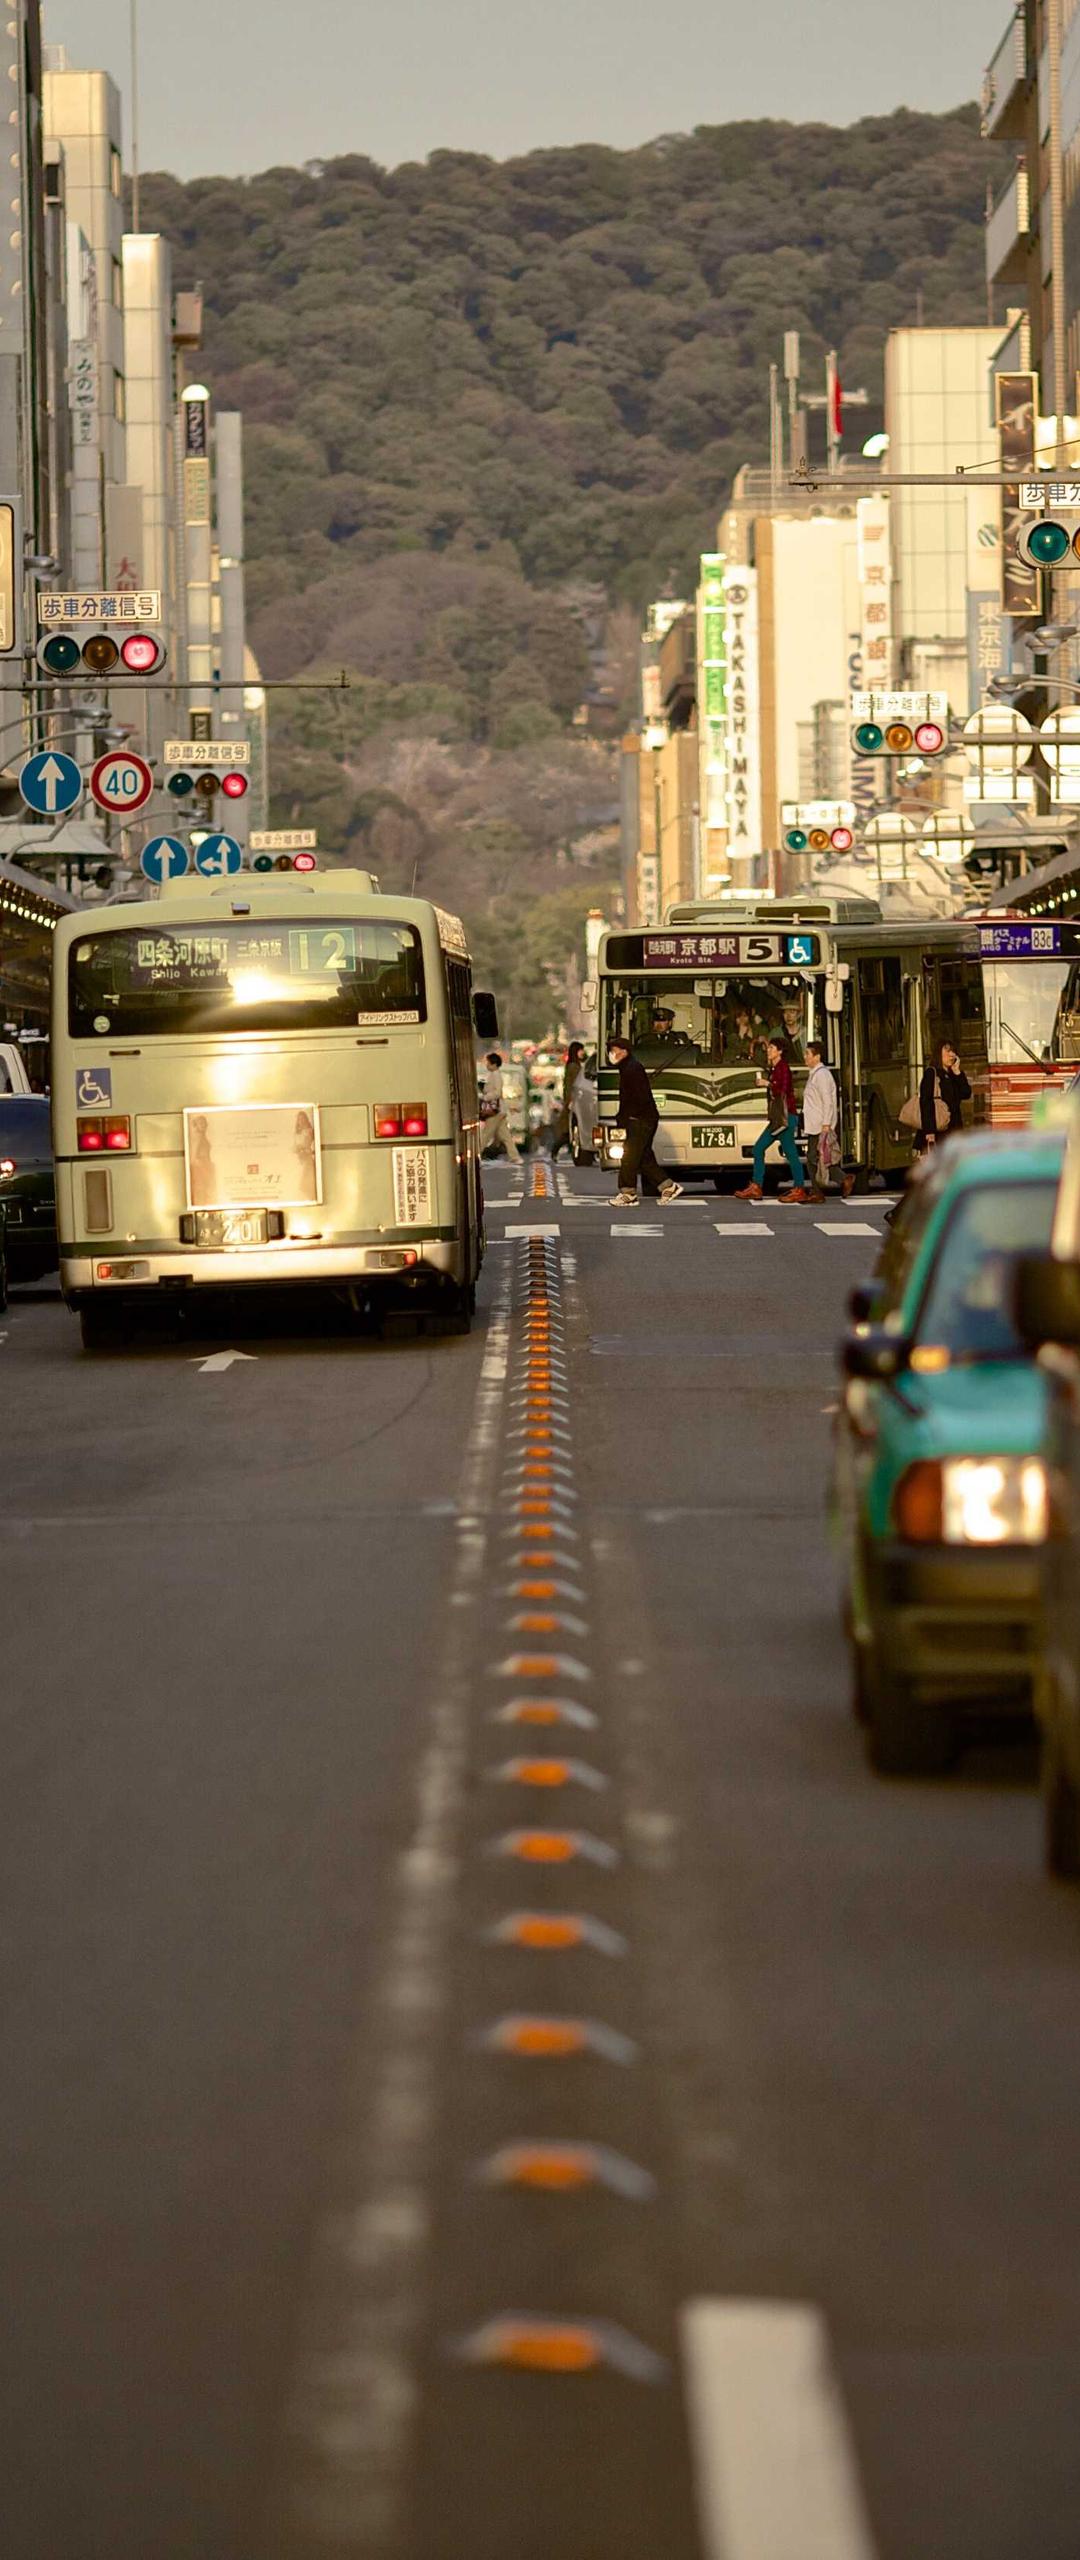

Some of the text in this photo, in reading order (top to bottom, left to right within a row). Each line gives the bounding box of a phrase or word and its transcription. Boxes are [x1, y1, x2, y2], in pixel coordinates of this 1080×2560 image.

[43, 597, 155, 618] 歩車分離信号
[731, 612, 748, 836] TAKASHIMAYA
[105, 769, 138, 796] 40
[137, 937, 229, 967] 四条河原町
[680, 938, 736, 955] 京都駅
[746, 938, 773, 960] 5
[151, 968, 181, 979] Shijo
